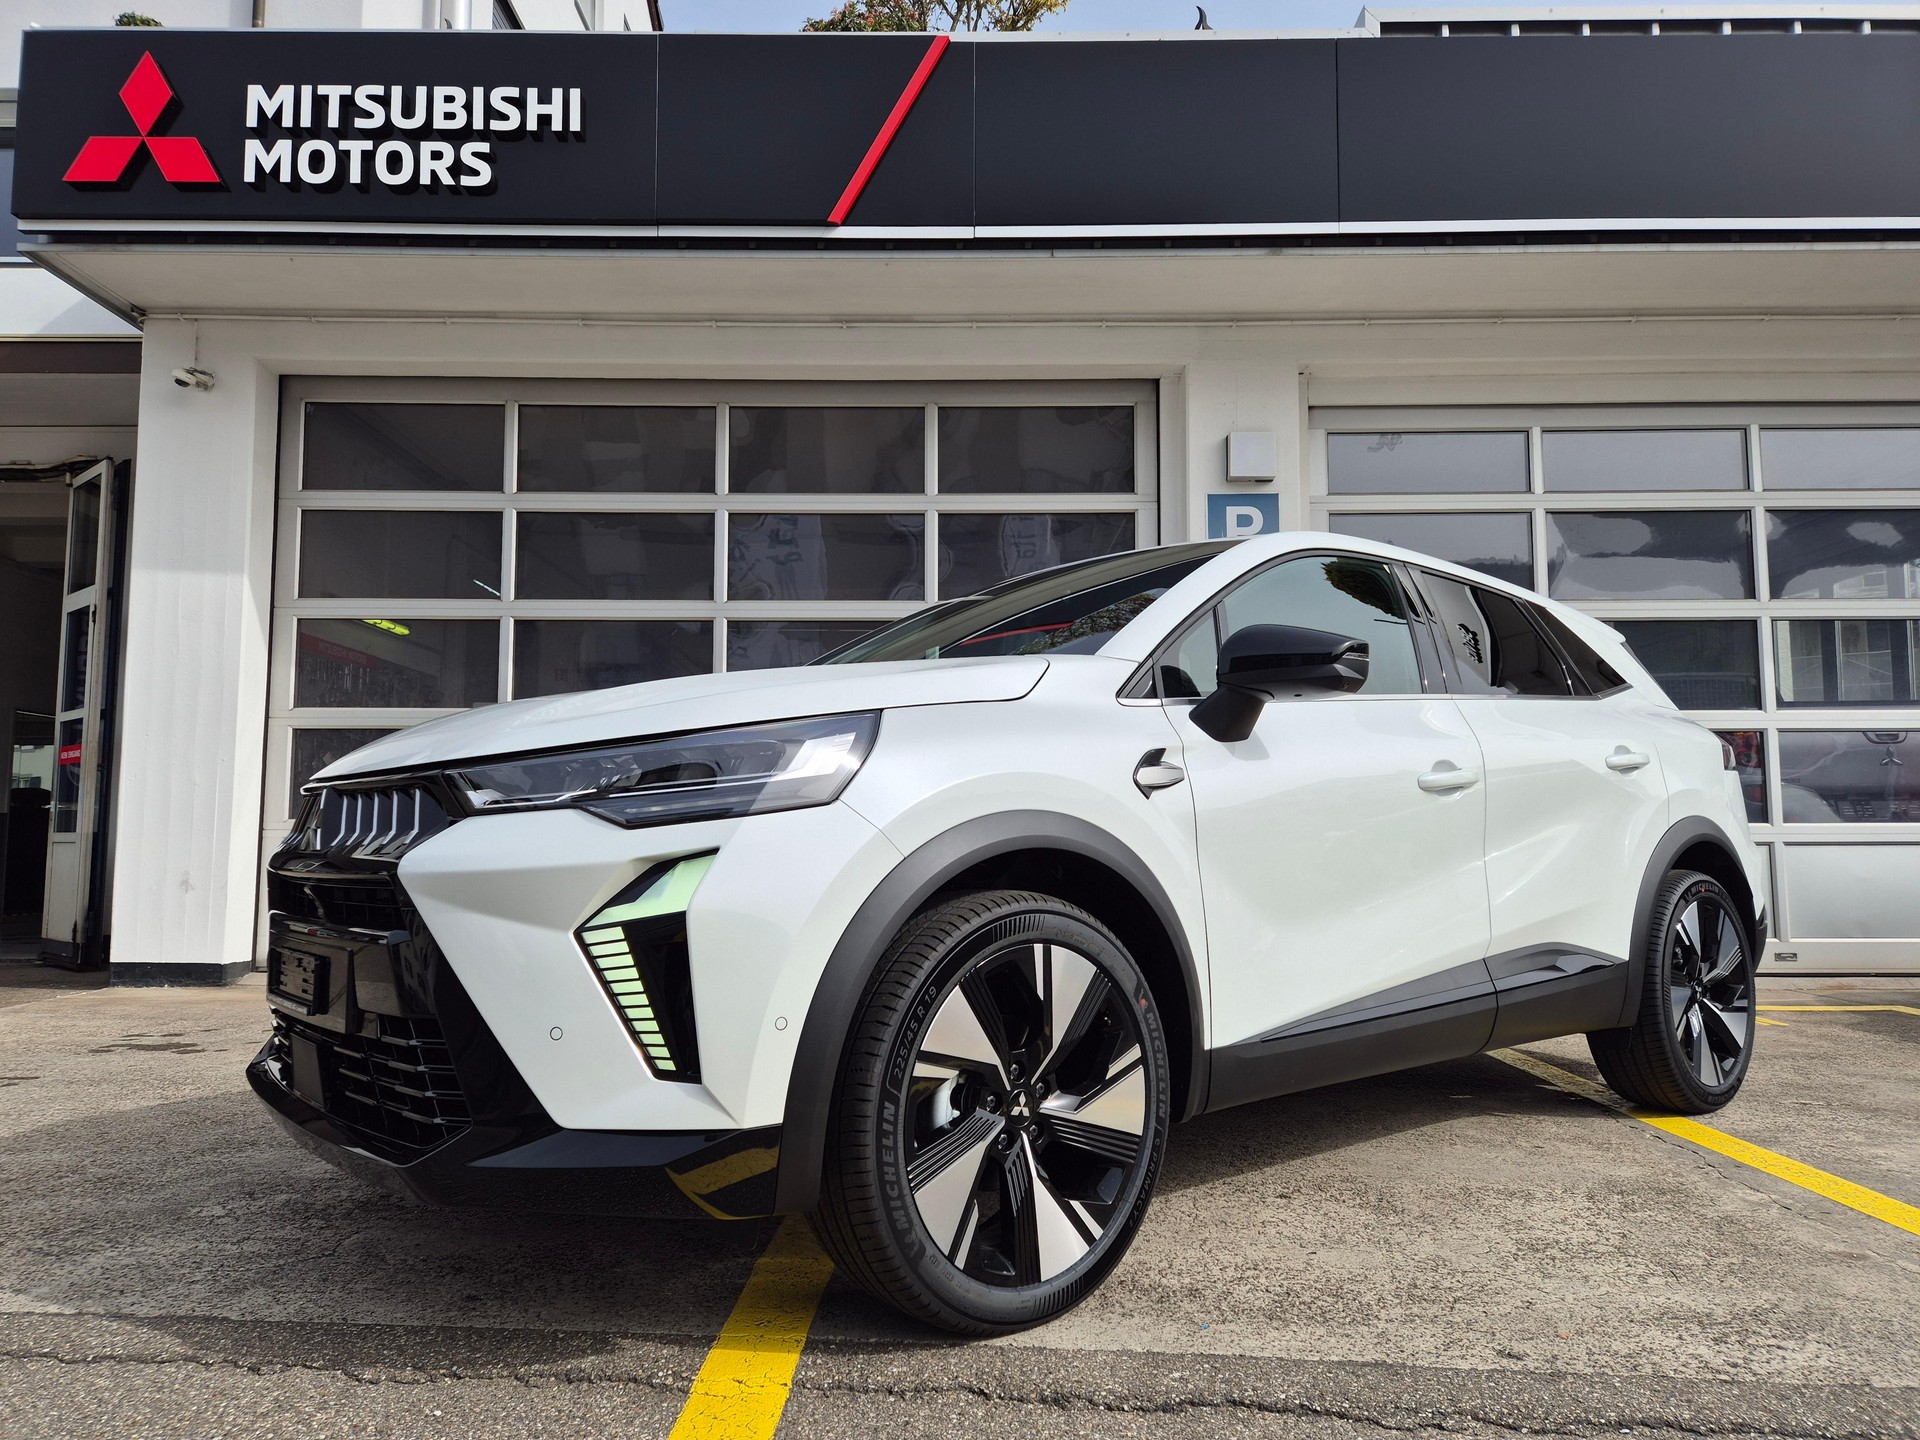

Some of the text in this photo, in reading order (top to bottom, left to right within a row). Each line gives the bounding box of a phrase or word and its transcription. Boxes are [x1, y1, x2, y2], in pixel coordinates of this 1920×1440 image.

[245, 84, 581, 132] MITSUBISHI
[243, 139, 492, 187] MOTORS
[1226, 505, 1264, 538] P
[1691, 882, 1720, 896] MICHELIN
[893, 986, 937, 1080] 225/45 R 19
[1145, 1012, 1166, 1120] MICHELIN
[881, 1100, 909, 1231] MICHELIN
